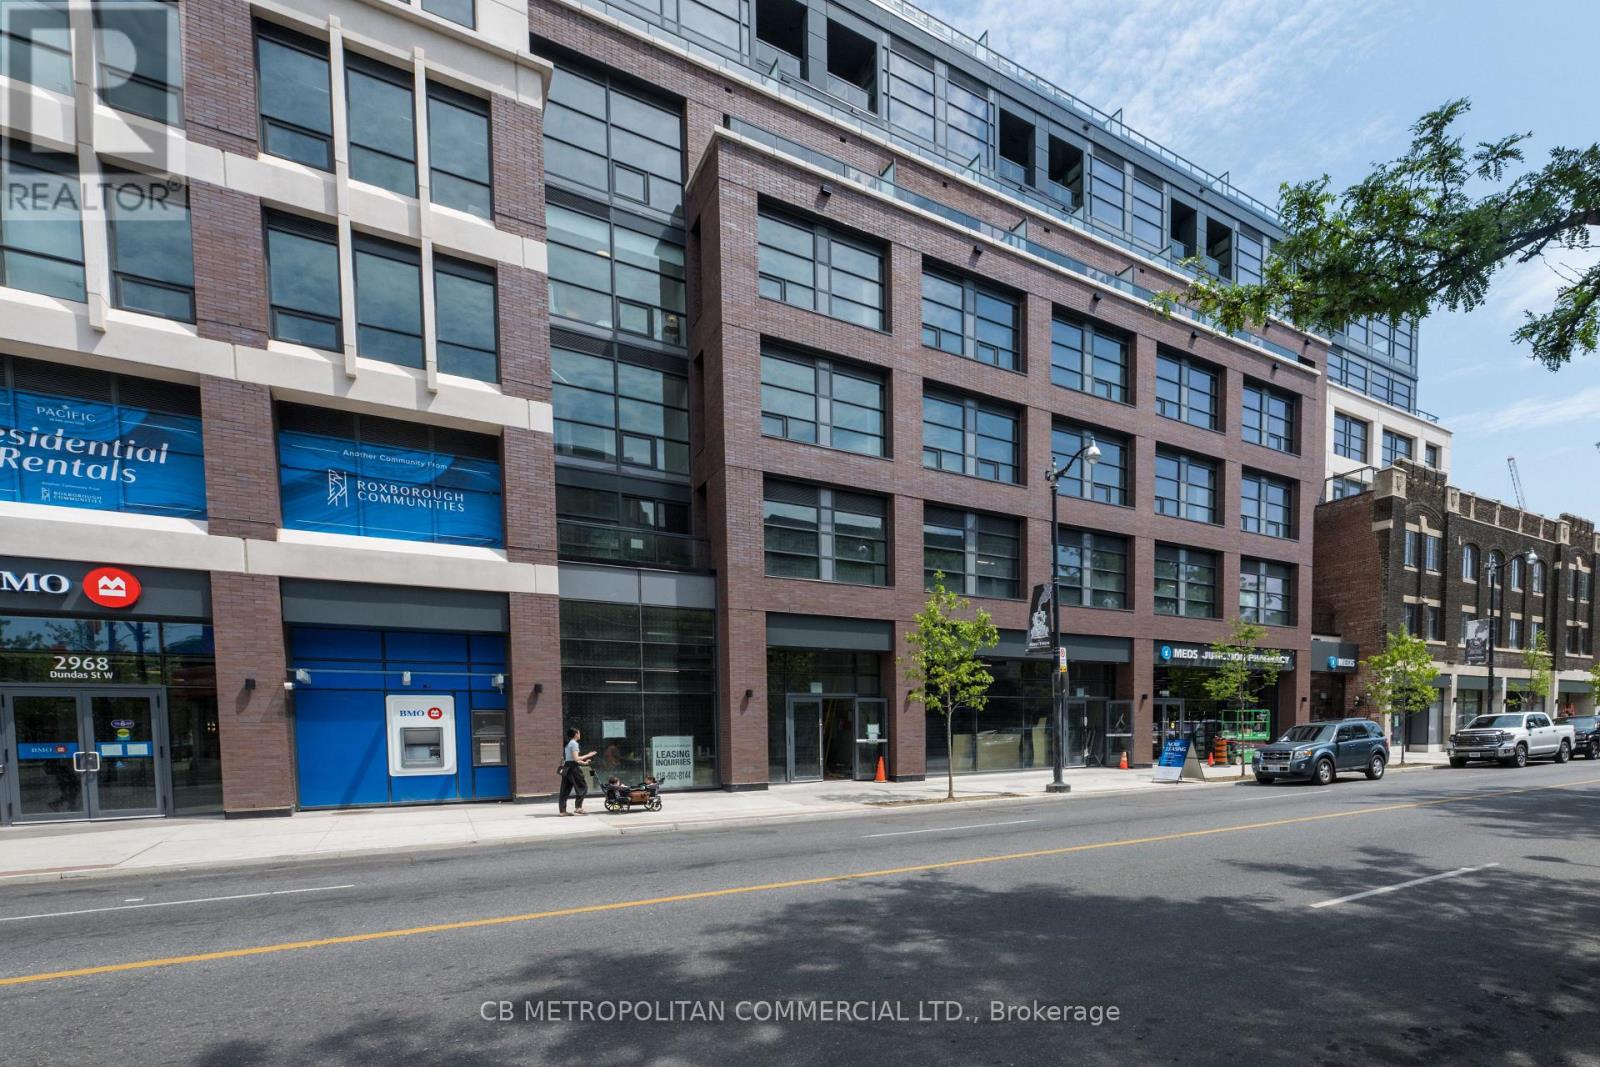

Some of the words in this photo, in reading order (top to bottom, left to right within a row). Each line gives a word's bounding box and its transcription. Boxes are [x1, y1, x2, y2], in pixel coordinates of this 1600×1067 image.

[36, 406, 96, 422] PACIFIC
[0, 446, 137, 484] Rentals
[343, 449, 377, 460] Another
[380, 454, 426, 468] Community
[428, 461, 448, 470] From
[357, 480, 464, 502] ROXBOROUGH
[357, 491, 465, 512] COMMUNITIES
[1173, 648, 1199, 660] MEDS
[53, 655, 109, 671] 2968
[50, 670, 89, 679] Dundas
[91, 671, 102, 679] St
[103, 671, 113, 679] W
[656, 750, 690, 758] LEASING
[655, 758, 691, 767] INQUIRIES
